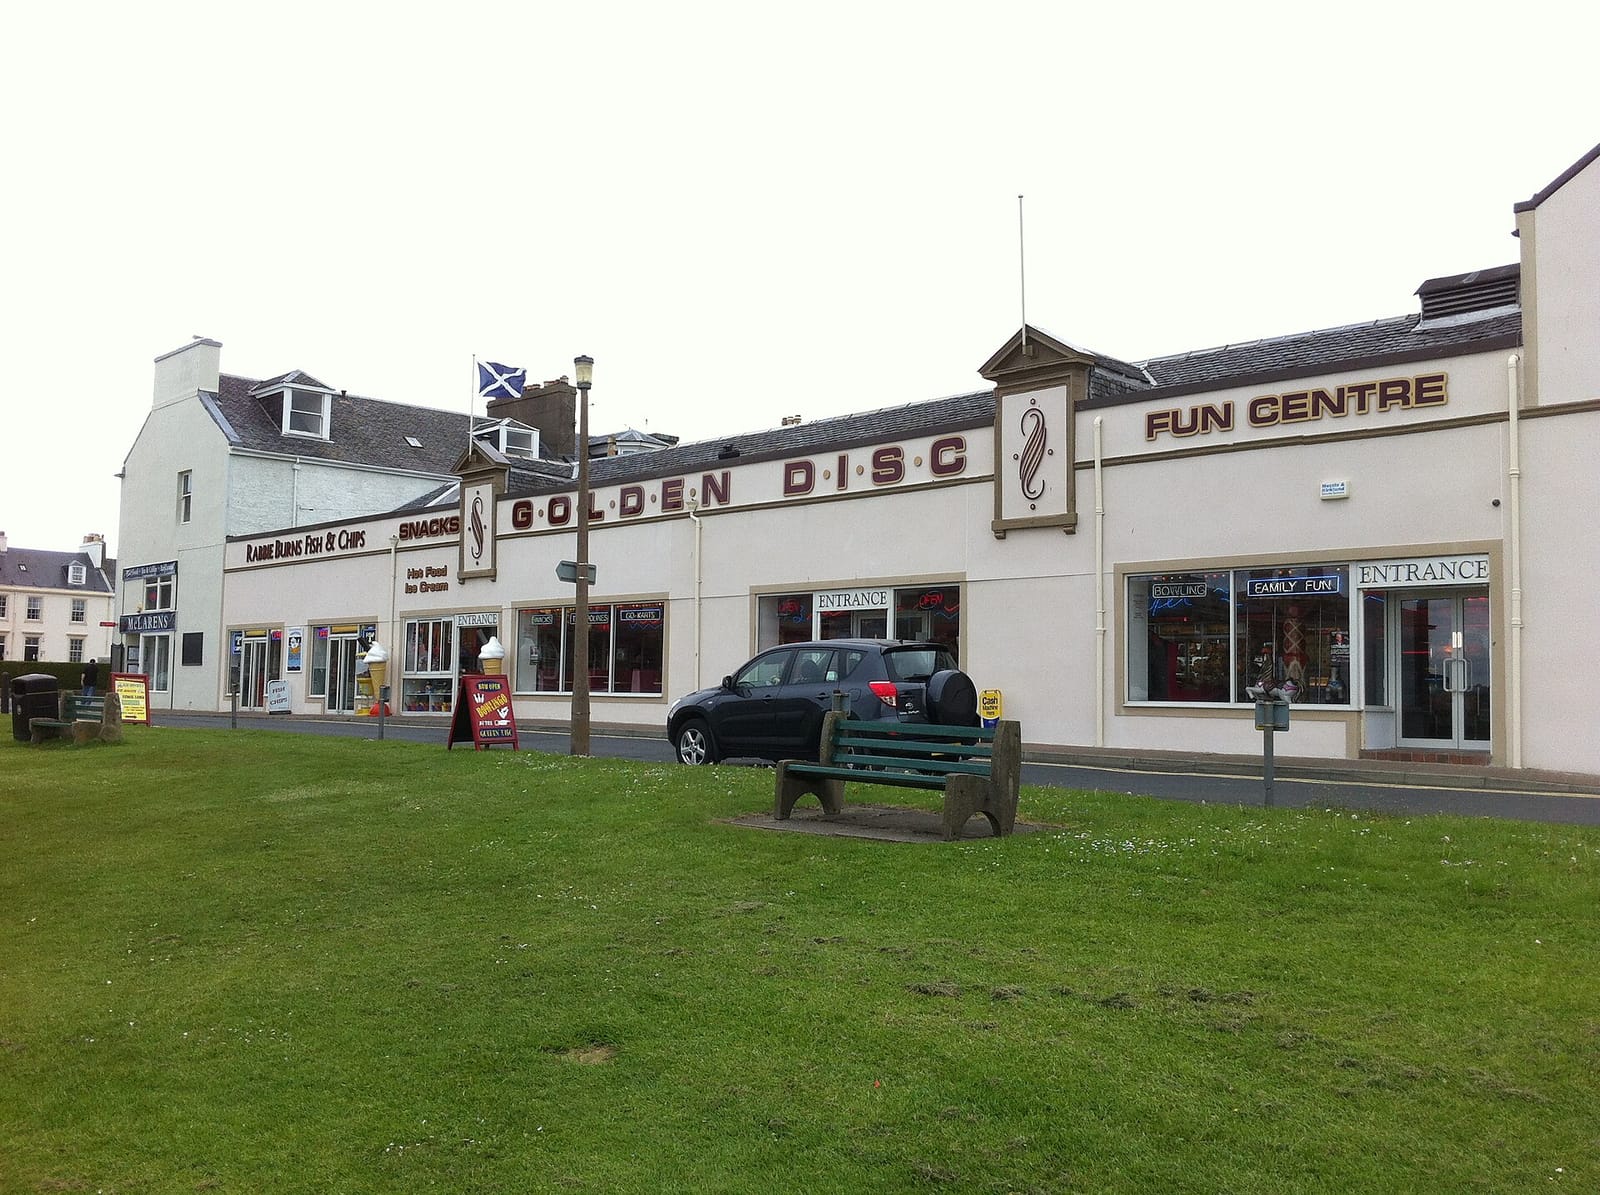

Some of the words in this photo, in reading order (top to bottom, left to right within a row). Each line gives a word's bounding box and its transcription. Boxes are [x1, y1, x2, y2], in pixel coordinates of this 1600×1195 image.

[1145, 400, 1234, 442] FUN
[1248, 371, 1448, 428] CENTRE
[399, 516, 460, 541] SNACKS
[275, 539, 302, 559] BURNS
[304, 535, 323, 555] FISH
[325, 532, 336, 551] &
[338, 530, 365, 550] CHIPS
[407, 568, 423, 579] Hot
[425, 565, 448, 577] Food
[1359, 560, 1489, 583] ENTRANCE
[405, 583, 417, 594] Ice
[420, 581, 448, 593] Cream
[1154, 584, 1206, 597] BOWLING
[1254, 580, 1297, 595] FAMILY
[1305, 579, 1332, 591] FUN
[819, 592, 888, 608] ENTRANCE
[127, 616, 169, 630] McLARENS
[458, 614, 497, 625] ENTRANCE
[982, 695, 998, 706] Cash
